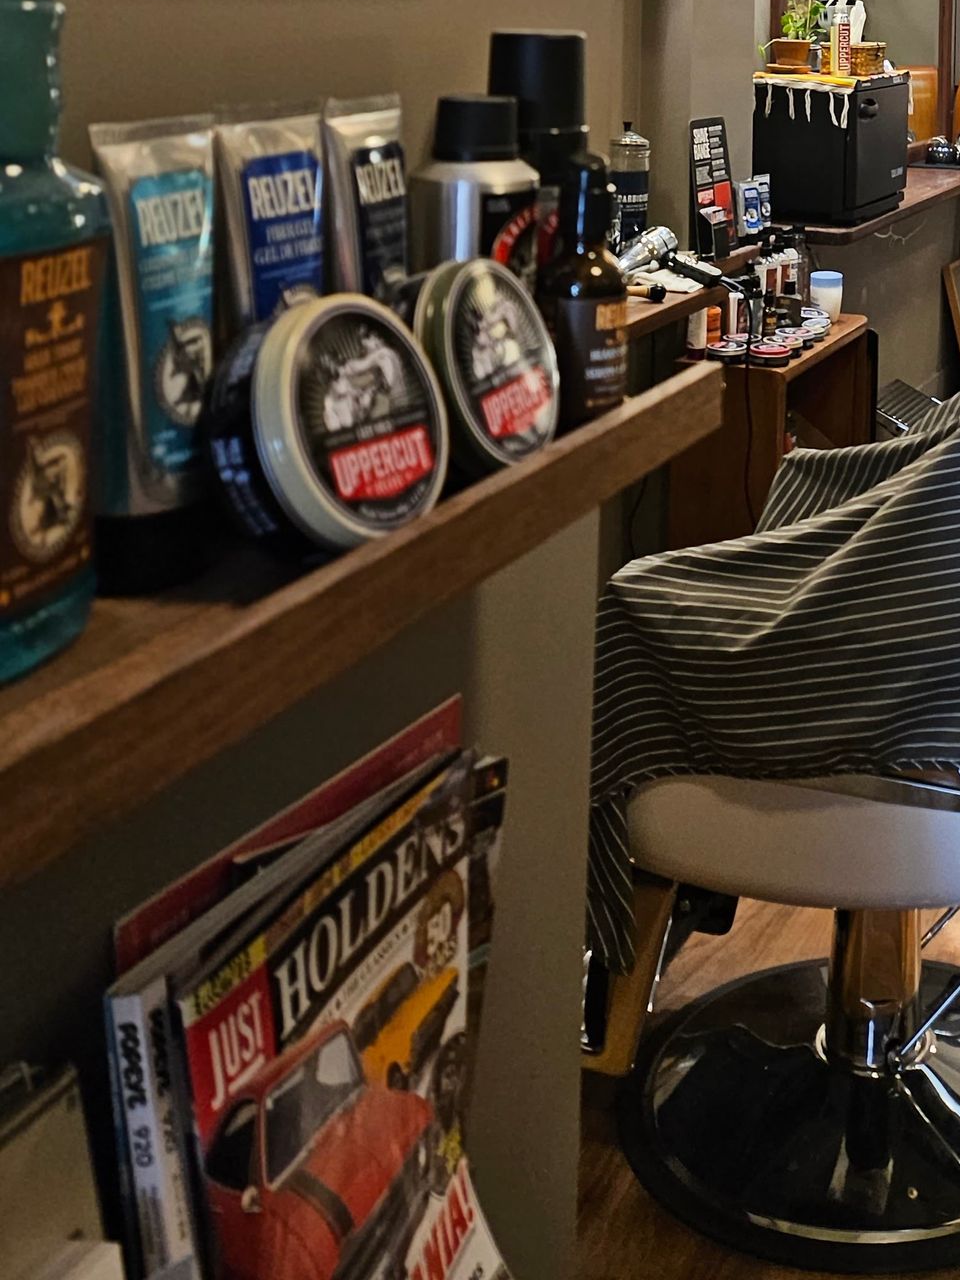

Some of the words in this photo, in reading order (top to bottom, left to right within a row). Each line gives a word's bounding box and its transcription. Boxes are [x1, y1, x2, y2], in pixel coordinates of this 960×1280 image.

[839, 23, 851, 71] UPPERCUT
[331, 425, 430, 498] UPPERCUT
[274, 815, 466, 1040] HOLDENS
[116, 1021, 148, 1110] POPEYE
[210, 991, 267, 1111] JUST
[132, 1124, 155, 1170] 920
